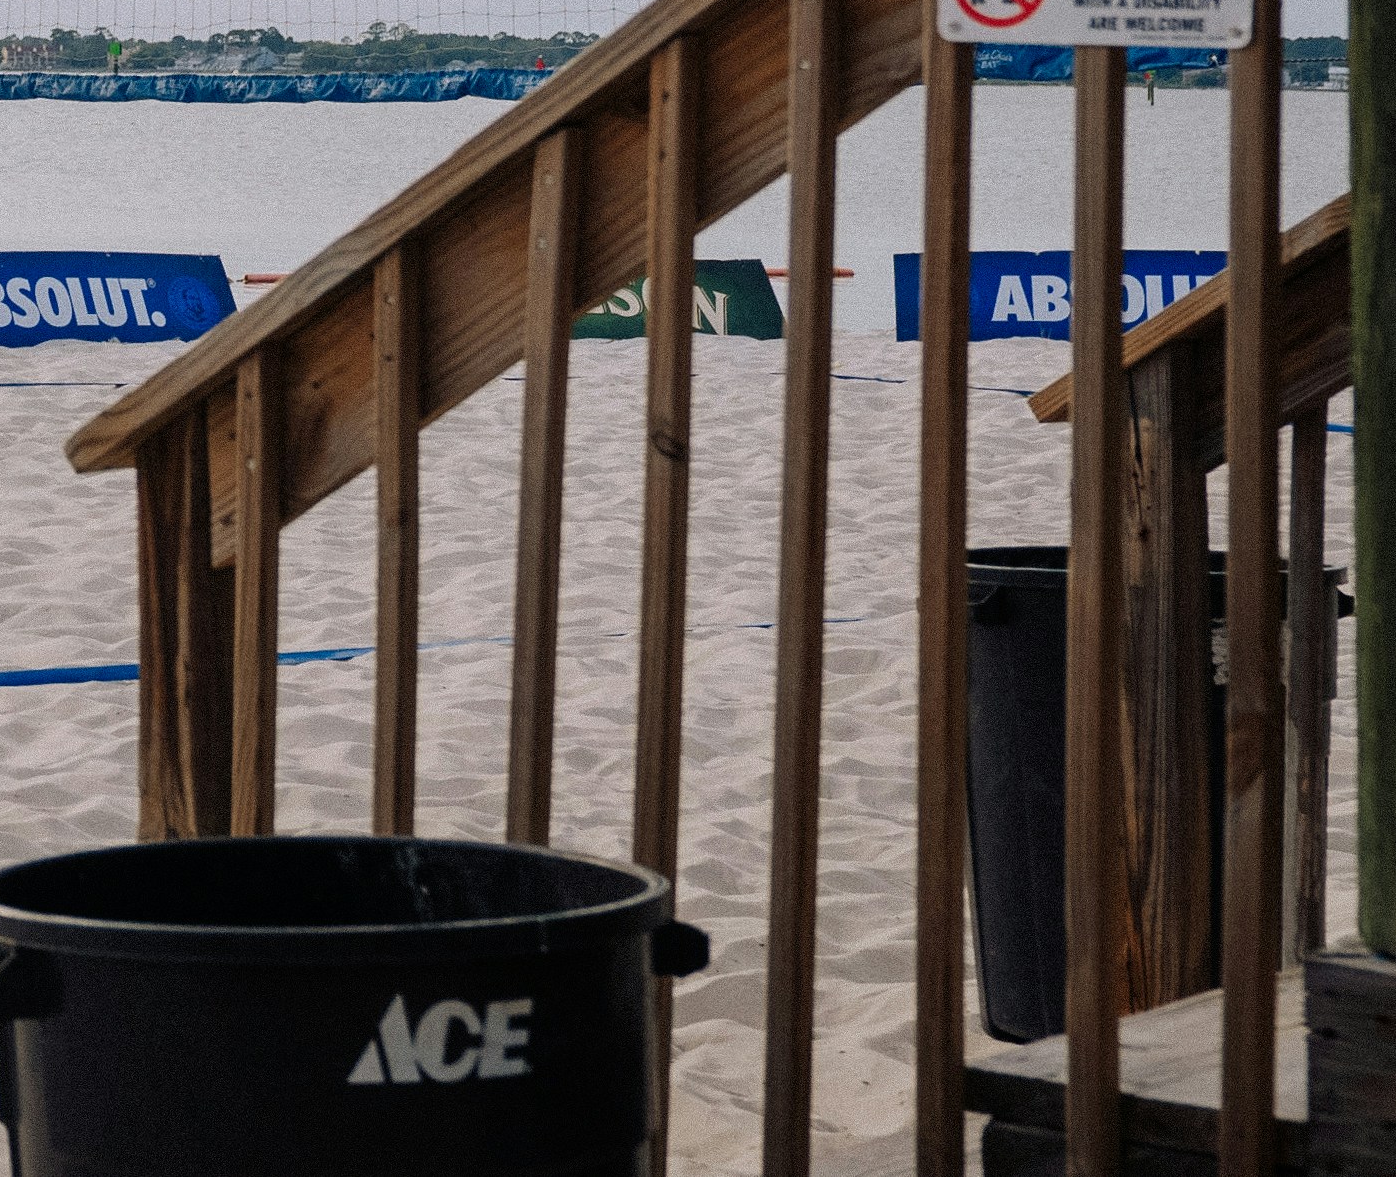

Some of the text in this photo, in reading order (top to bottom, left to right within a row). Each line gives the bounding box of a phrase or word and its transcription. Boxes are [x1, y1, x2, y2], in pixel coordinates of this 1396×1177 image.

[1088, 16, 1205, 32] ARE WELCOME
[347, 994, 534, 1085] ACE
